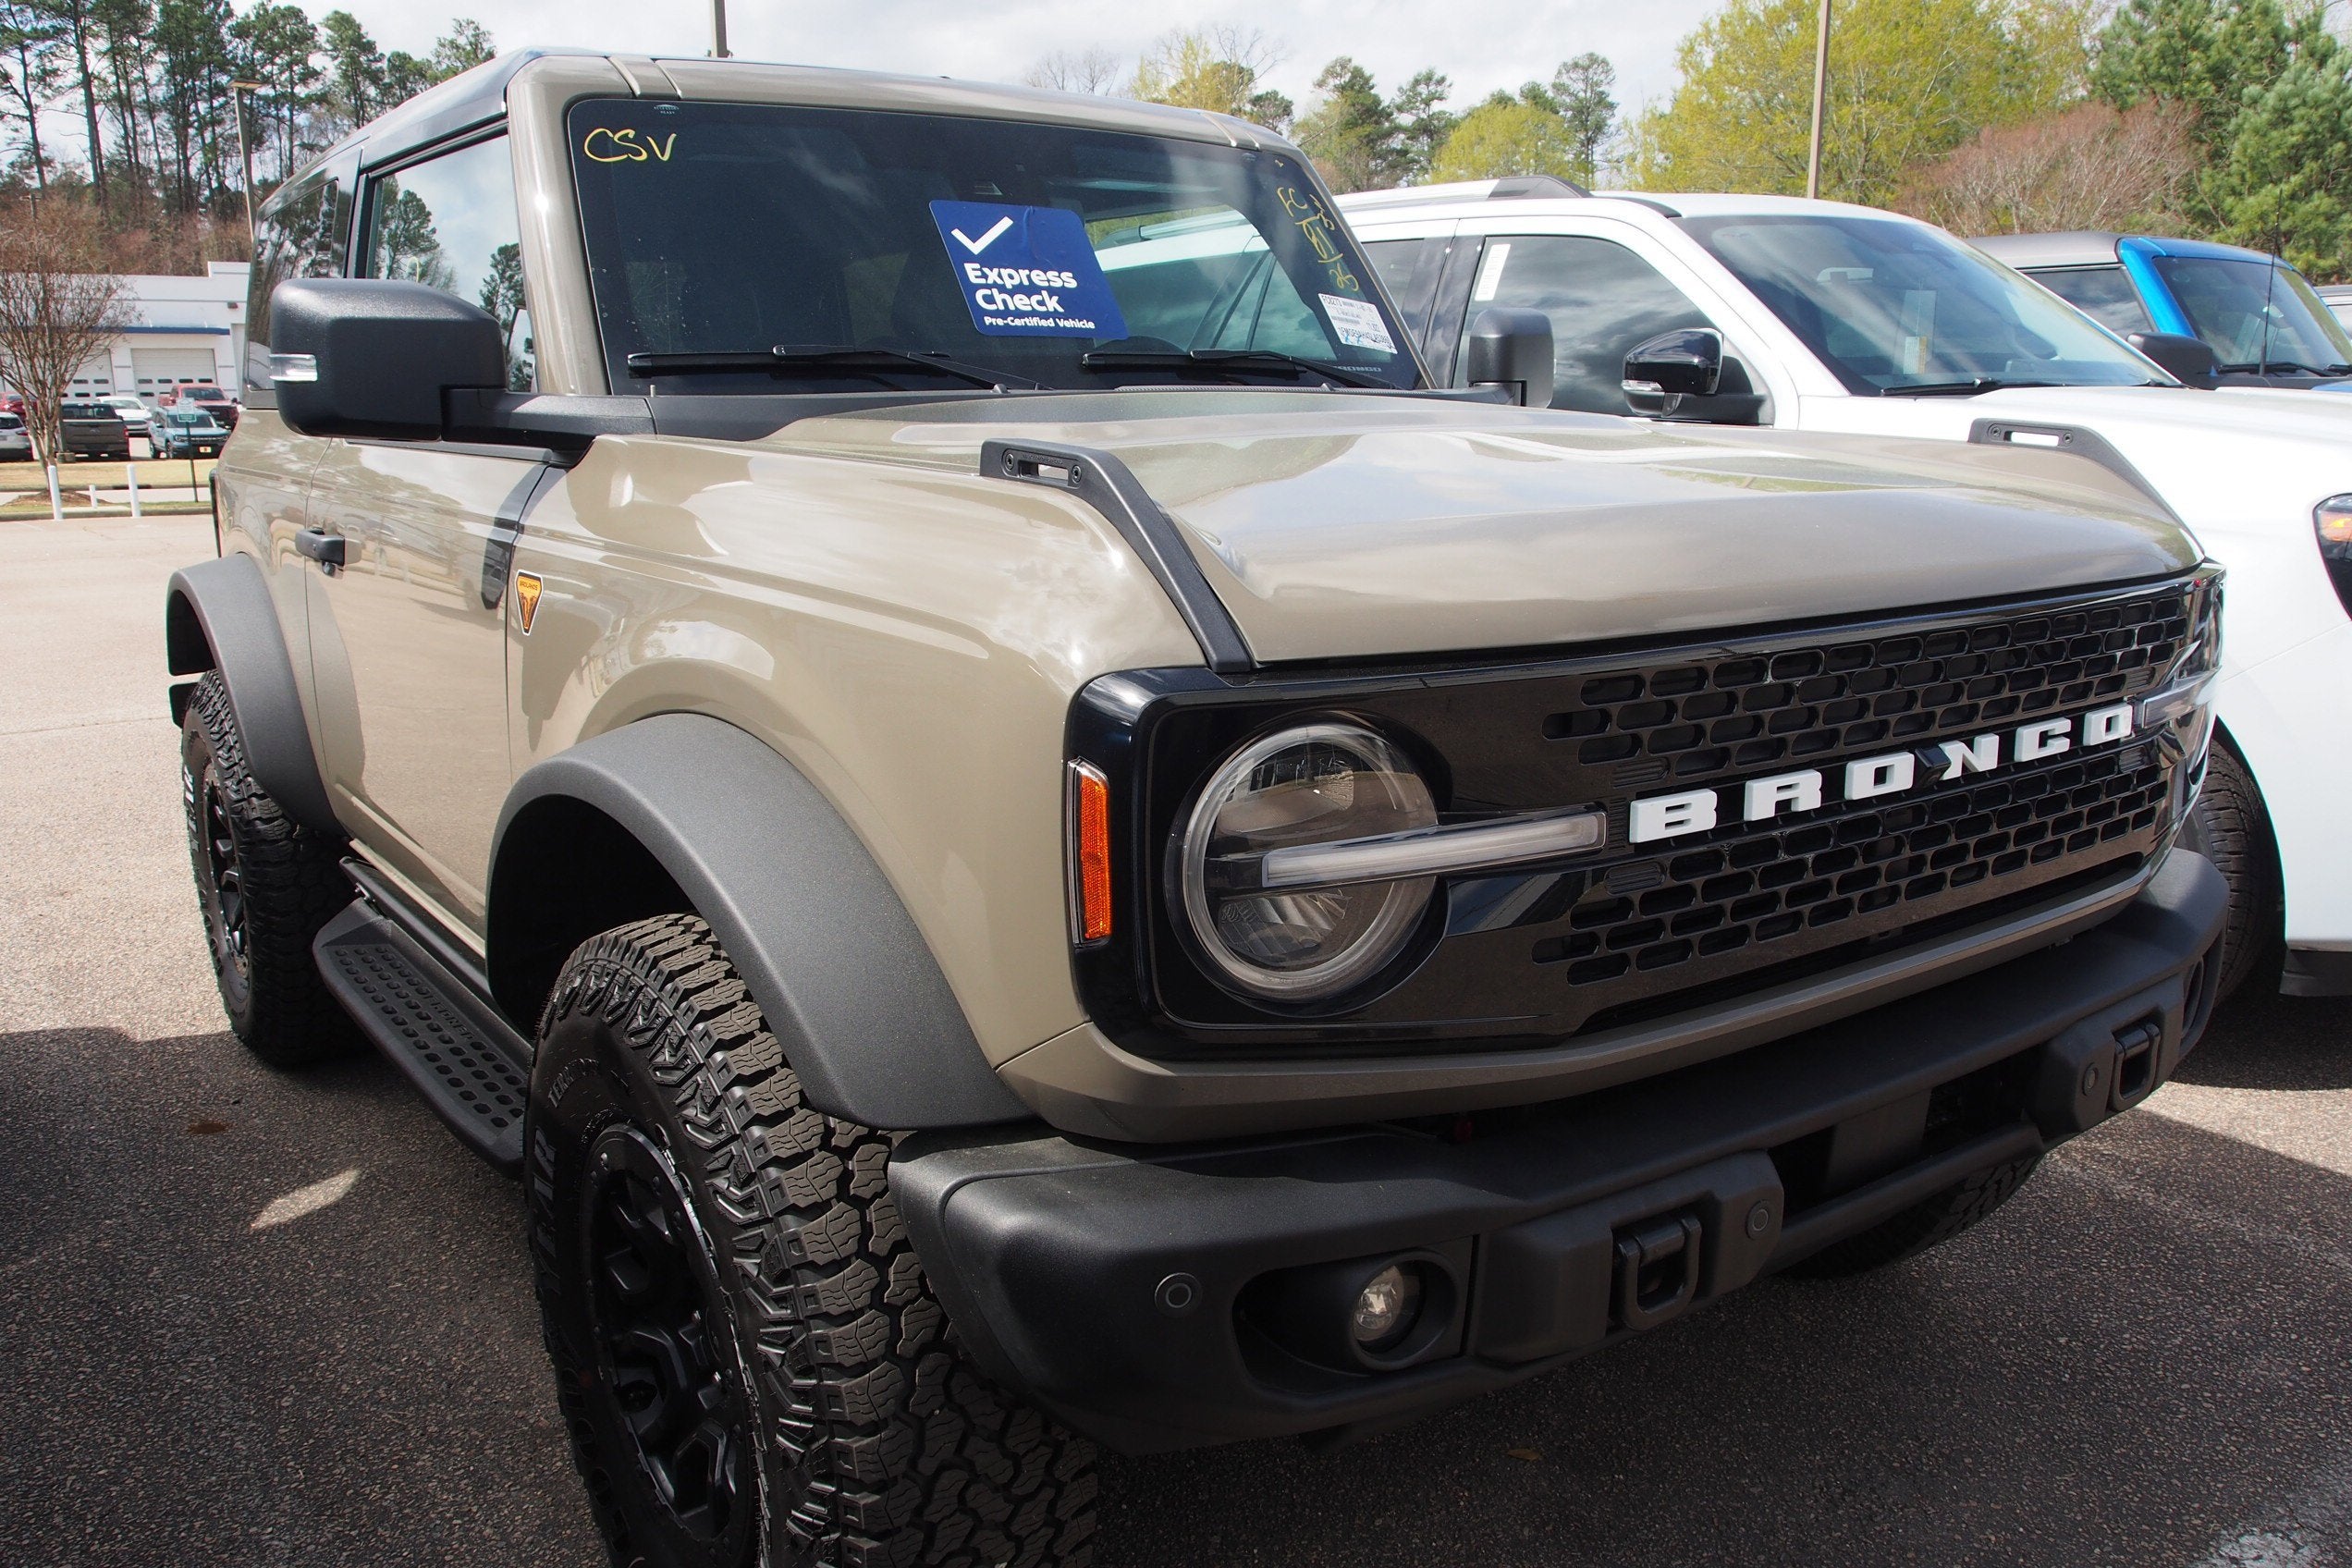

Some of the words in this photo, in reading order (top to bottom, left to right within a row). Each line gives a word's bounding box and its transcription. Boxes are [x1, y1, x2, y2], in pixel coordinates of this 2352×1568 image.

[583, 127, 678, 164] CSV
[963, 262, 1078, 288] Express
[975, 288, 1065, 312] Check
[984, 315, 1056, 328] Pre-Certified
[1057, 318, 1096, 329] Vehicle
[1627, 702, 2135, 844] BRONCO
